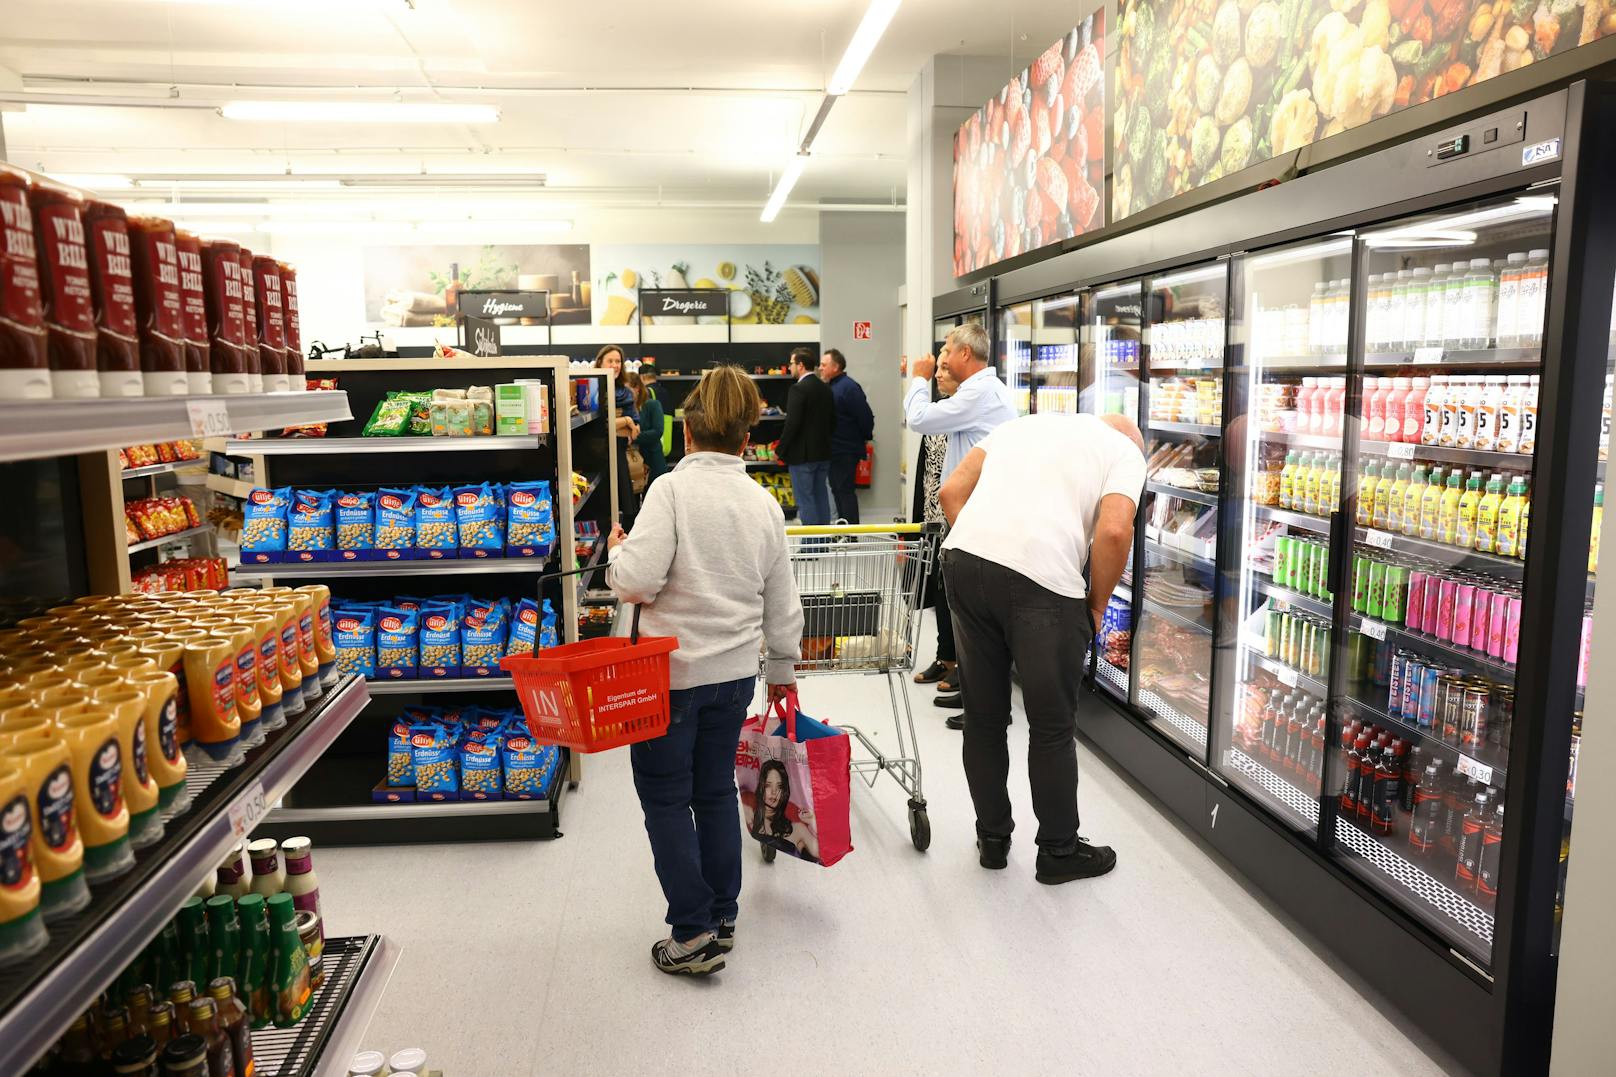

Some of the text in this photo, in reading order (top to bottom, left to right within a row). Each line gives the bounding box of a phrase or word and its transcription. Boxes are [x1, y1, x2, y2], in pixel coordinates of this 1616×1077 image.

[482, 298, 524, 316] Hygiene
[662, 296, 707, 314] Drogerie
[1425, 409, 1431, 424] 5
[1444, 410, 1450, 425] 5
[1460, 411, 1466, 427] 5
[1479, 412, 1486, 428] 5
[1502, 413, 1509, 429] 5
[1525, 413, 1533, 430] 5
[514, 493, 533, 504] ültje
[340, 509, 368, 517] Erdnüsse
[598, 693, 657, 713] INTERSPAR GmbH
[607, 688, 648, 703] Eigentum der
[510, 739, 529, 749] ültje
